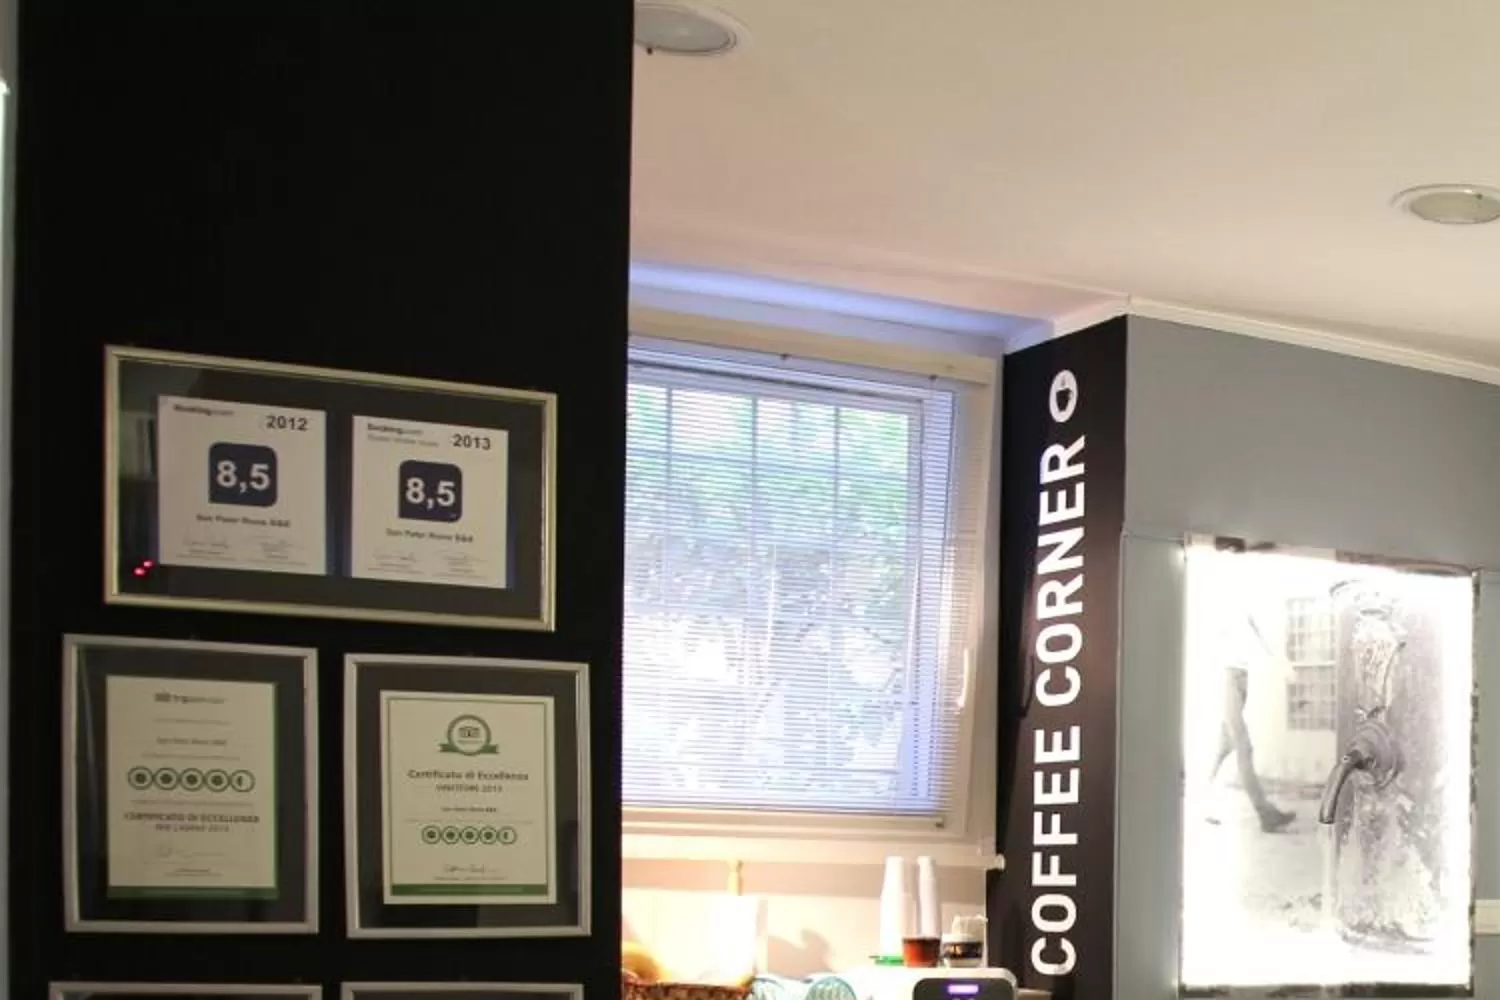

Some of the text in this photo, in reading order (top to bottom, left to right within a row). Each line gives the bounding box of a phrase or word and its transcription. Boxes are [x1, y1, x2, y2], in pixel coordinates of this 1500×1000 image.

[265, 415, 309, 432] 2012
[451, 433, 492, 451] 2013
[216, 459, 272, 493] 8,5
[404, 476, 457, 509] 8,5
[1031, 434, 1087, 977] COFFEE CORNER
